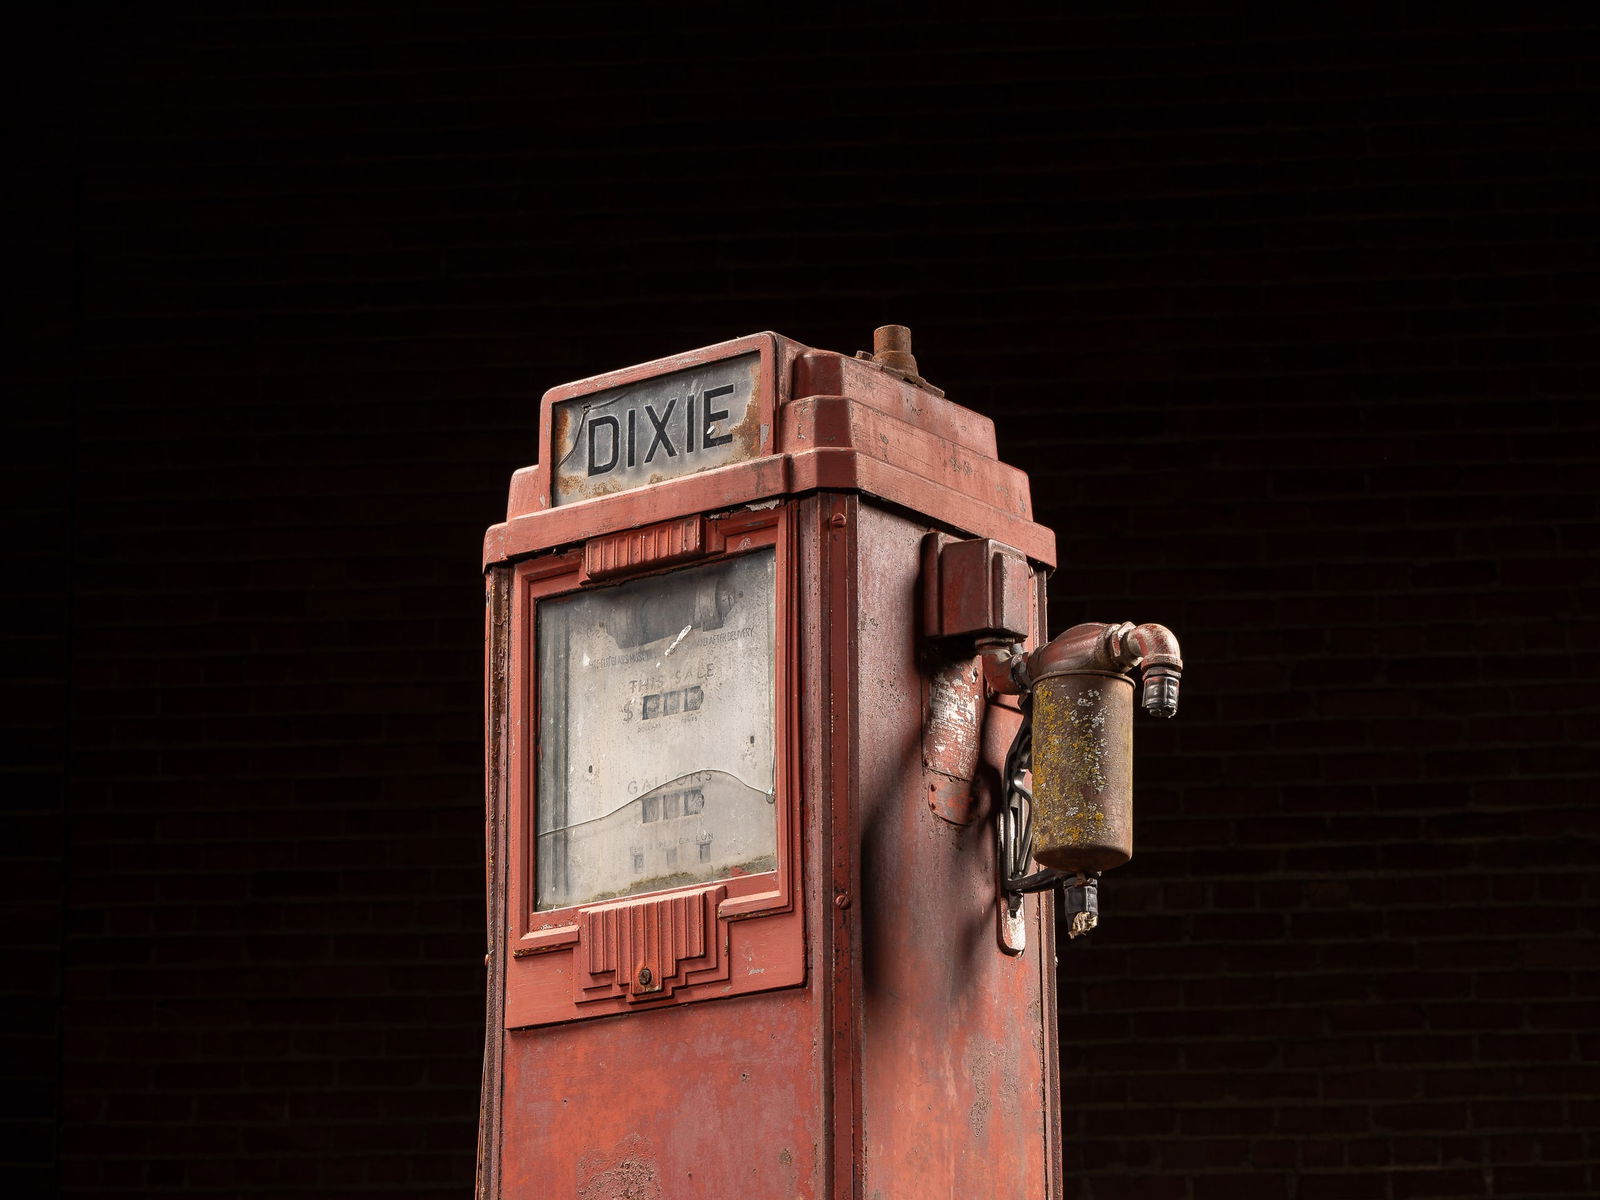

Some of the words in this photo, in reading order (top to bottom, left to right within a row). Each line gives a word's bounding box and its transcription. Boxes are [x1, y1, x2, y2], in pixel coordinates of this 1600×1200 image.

[588, 384, 734, 477] DIXIE
[629, 675, 664, 693] THIS
[675, 663, 714, 682] SALE
[627, 767, 712, 794] GALLONS
[679, 832, 713, 845] GALON
